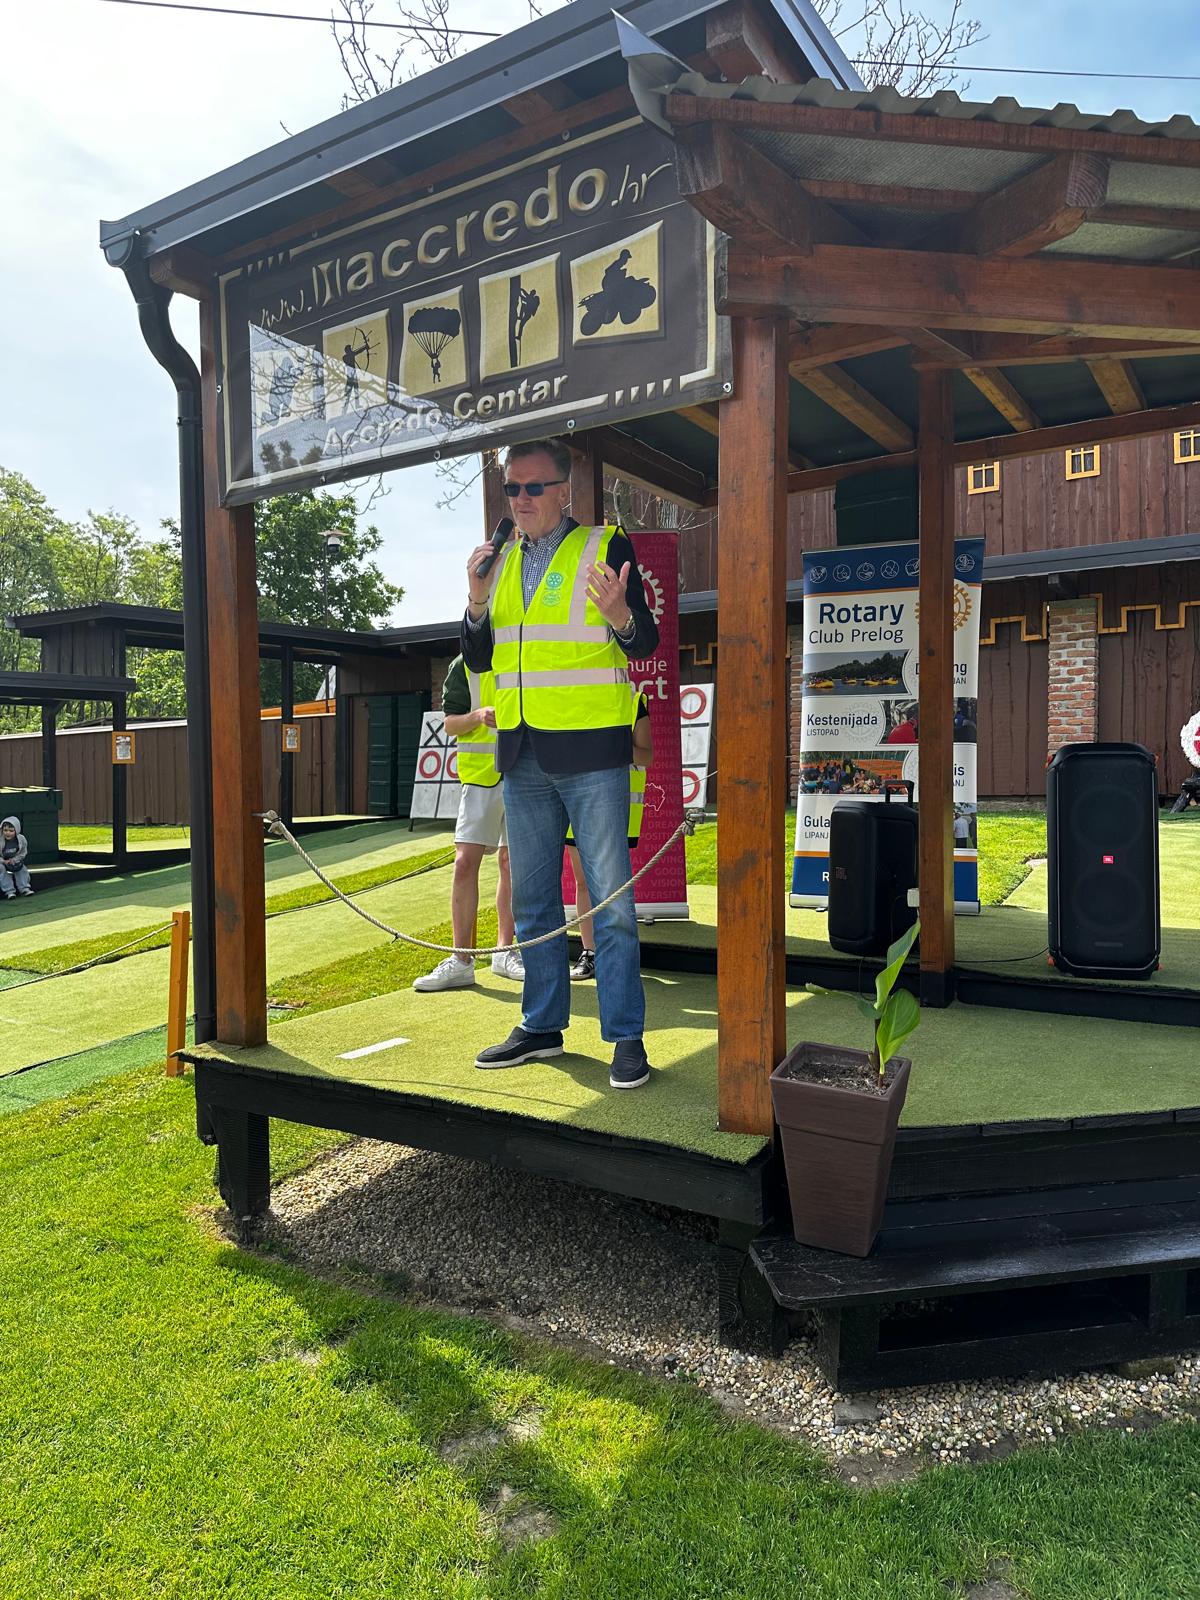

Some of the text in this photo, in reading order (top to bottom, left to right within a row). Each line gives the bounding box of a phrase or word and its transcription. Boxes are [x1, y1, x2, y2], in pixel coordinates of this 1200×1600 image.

[321, 374, 568, 456] Accredo Centar
[819, 603, 904, 625] Rotary
[809, 627, 904, 644] Club Prelog
[807, 713, 878, 728] Kestenijada
[806, 728, 840, 736] LISTOPAD
[804, 815, 831, 828] Gula
[805, 831, 829, 839] LIPANJ
